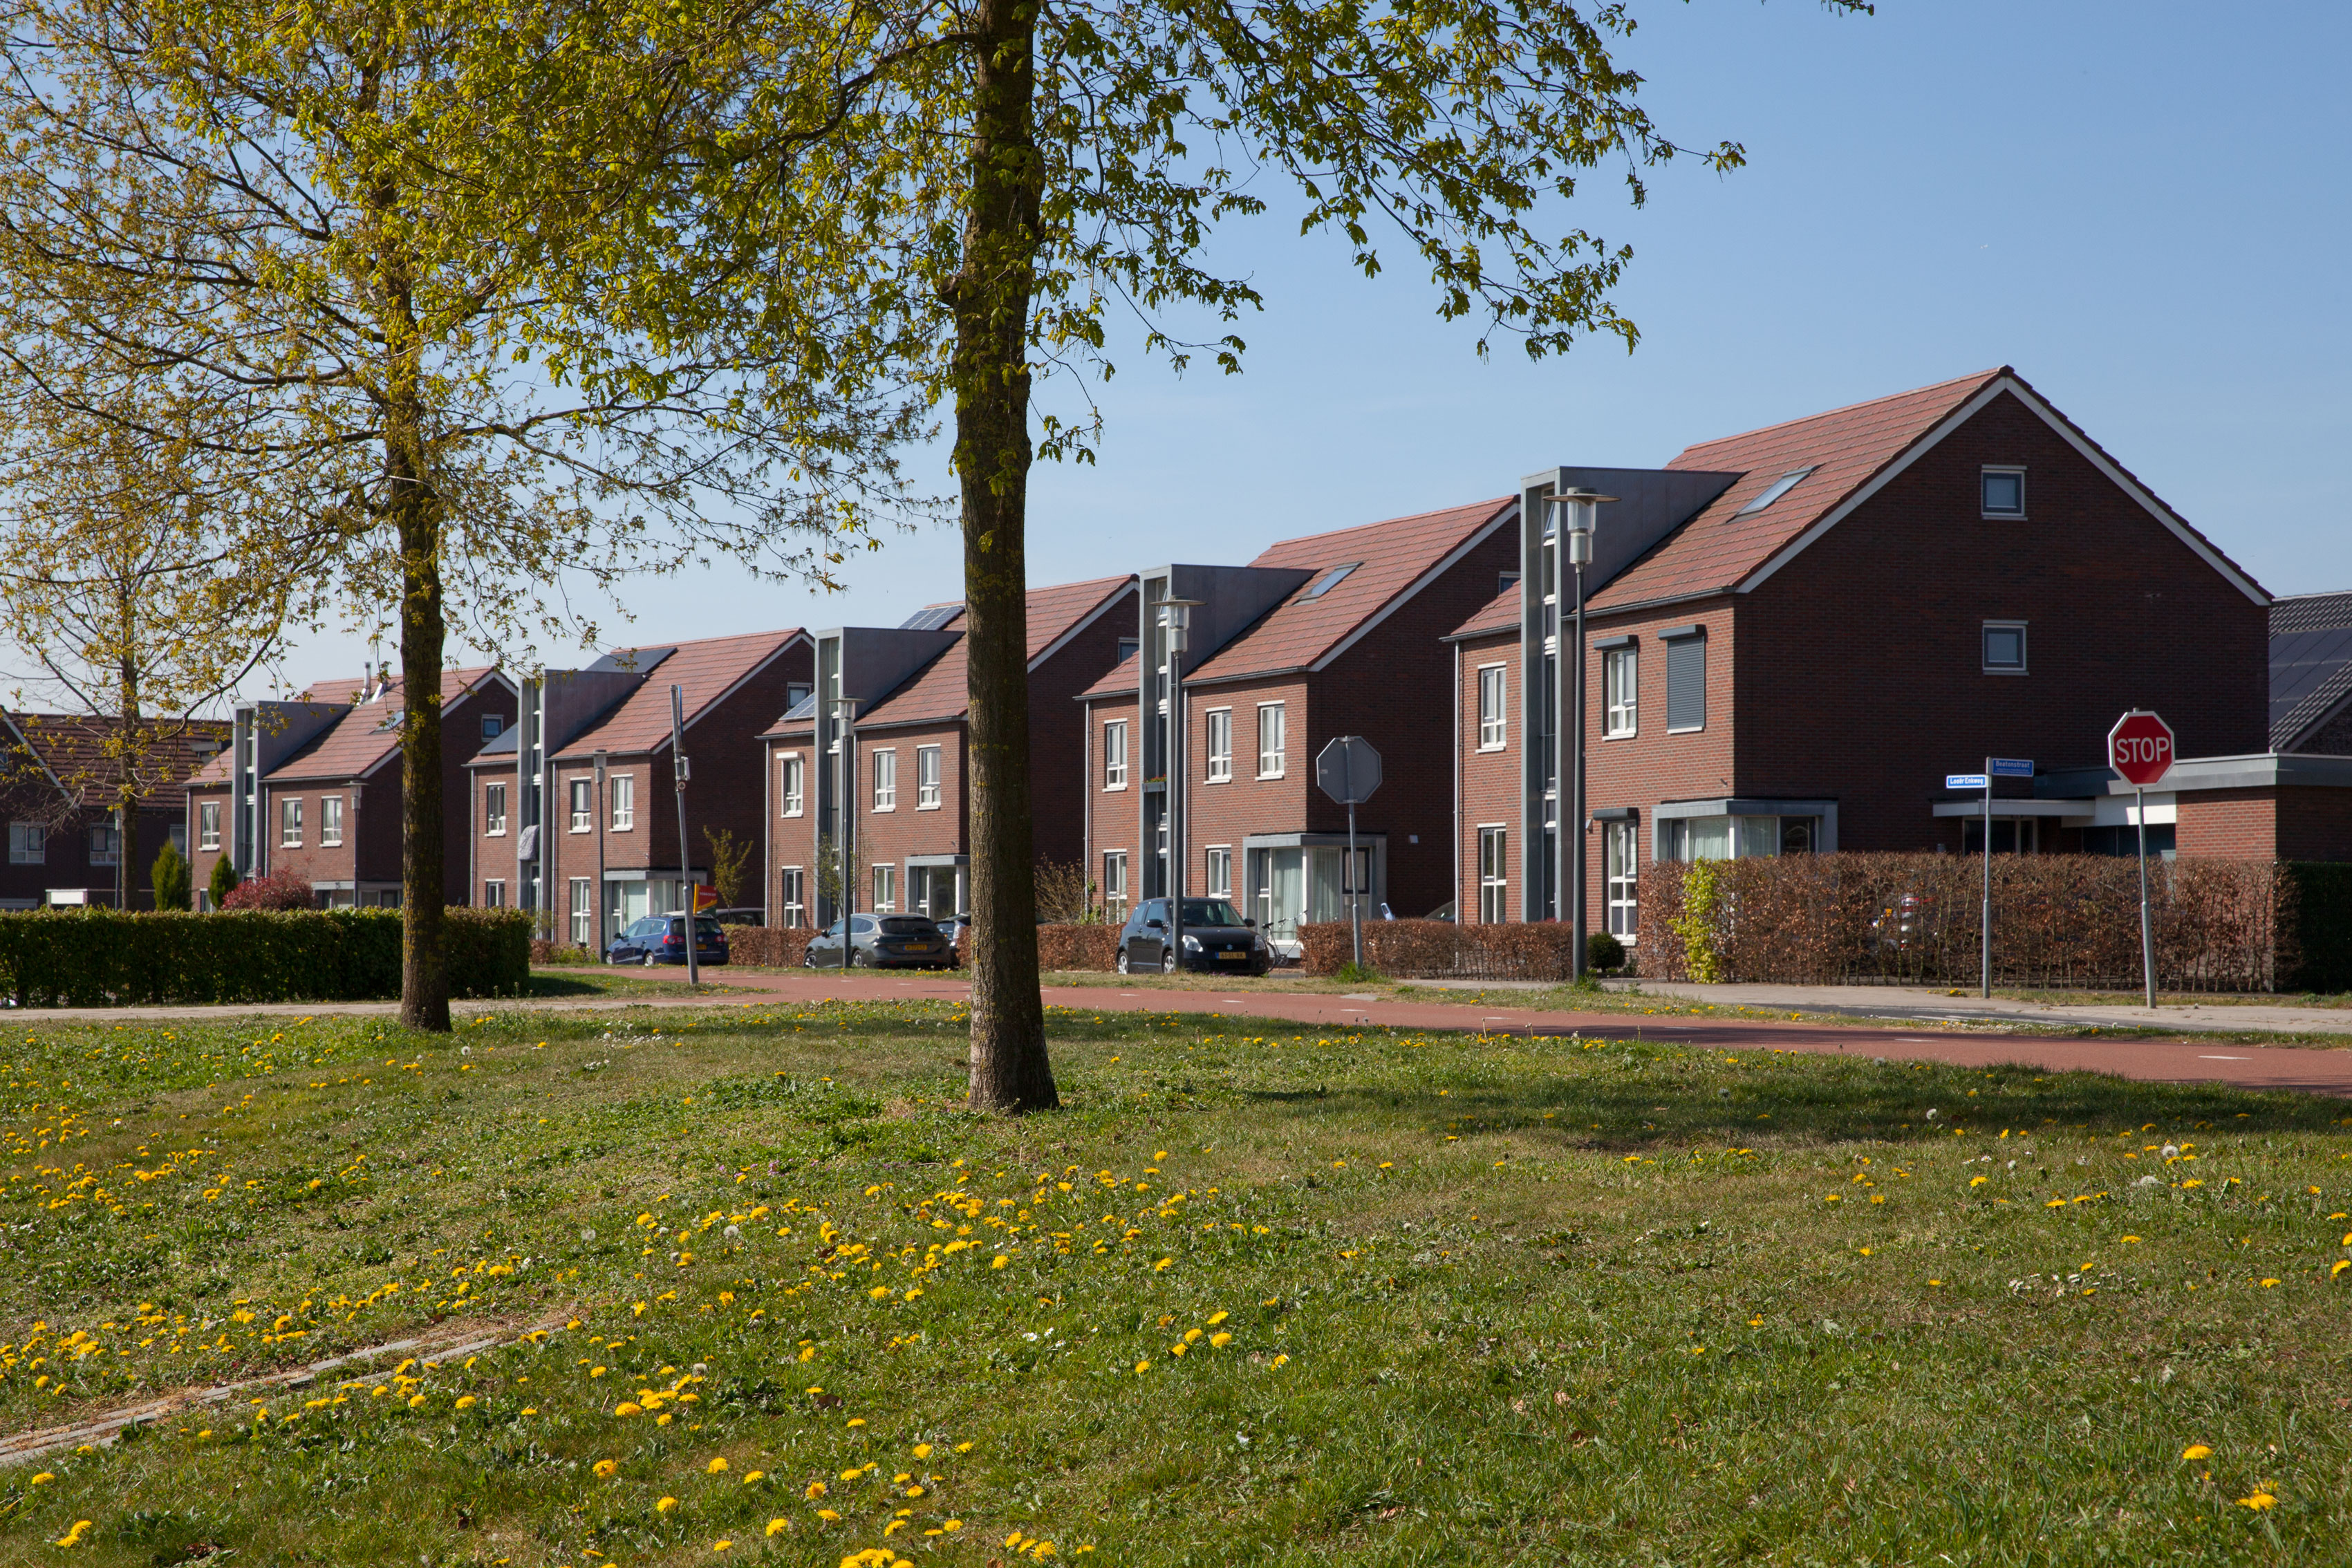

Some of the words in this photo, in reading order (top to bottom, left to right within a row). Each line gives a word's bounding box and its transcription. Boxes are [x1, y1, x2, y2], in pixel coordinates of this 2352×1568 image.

[2116, 736, 2169, 764] STOP
[1996, 760, 2030, 768] Beatonstraat
[1965, 777, 1984, 785] Enkweg
